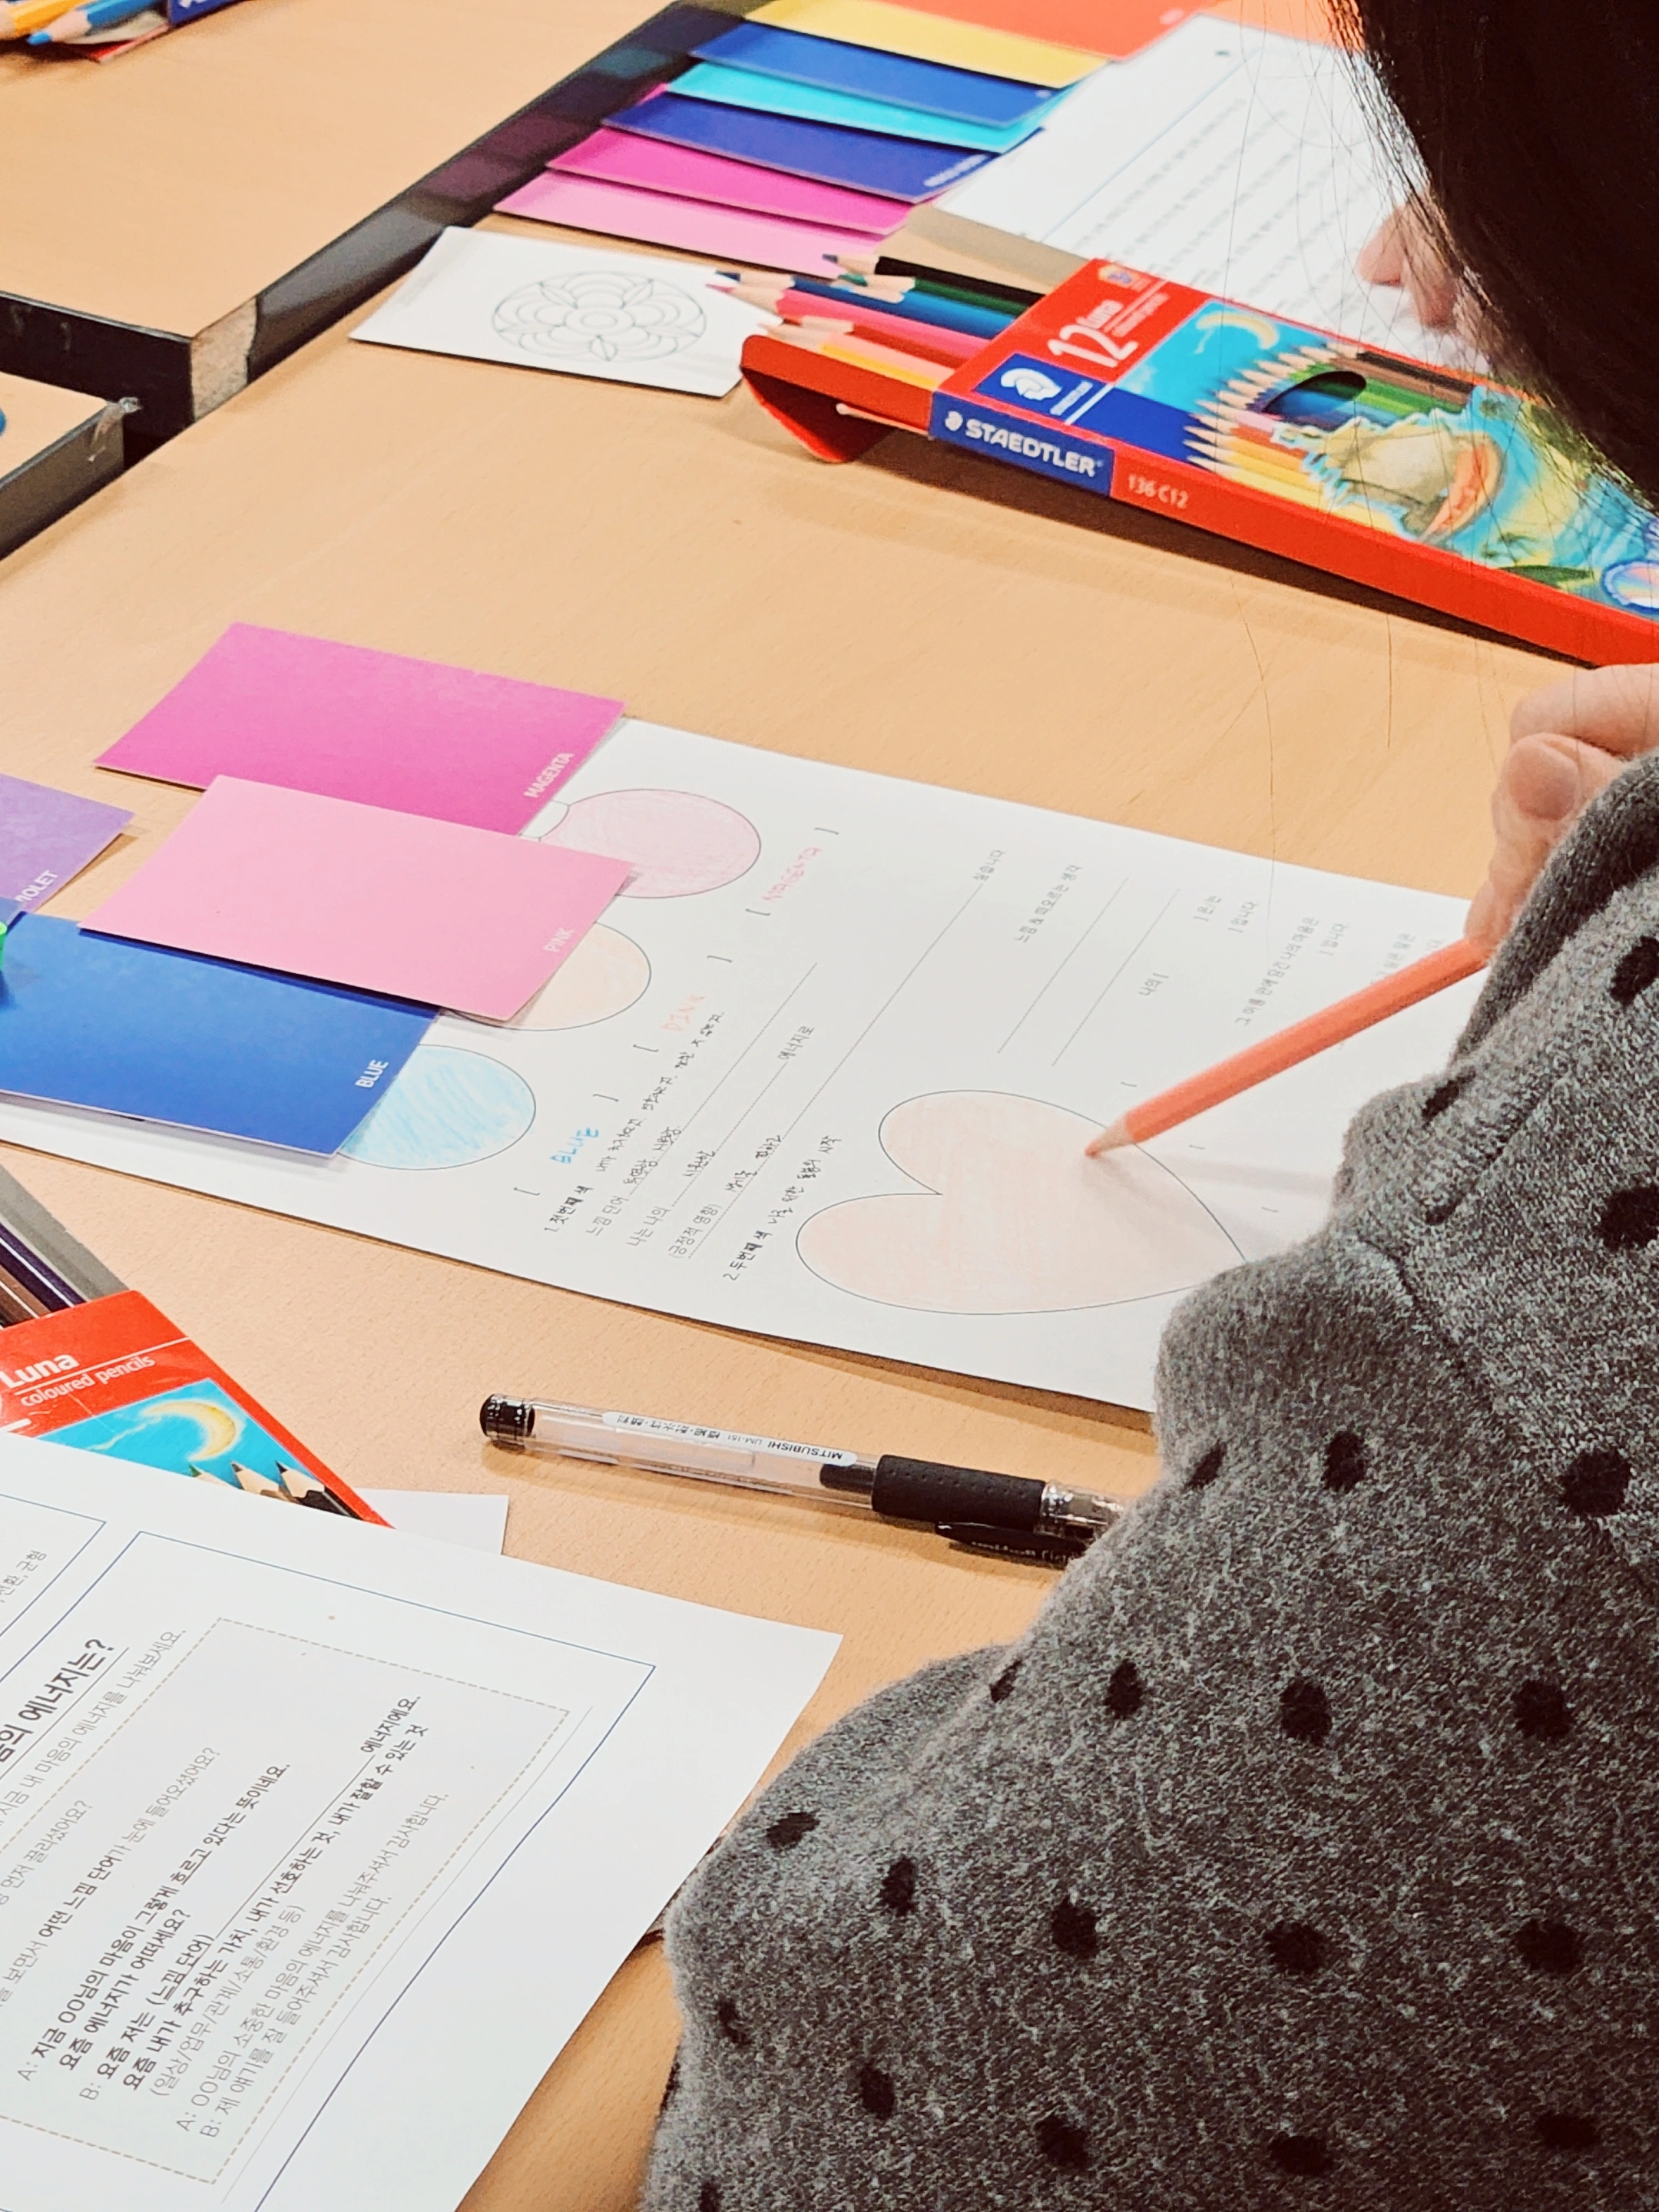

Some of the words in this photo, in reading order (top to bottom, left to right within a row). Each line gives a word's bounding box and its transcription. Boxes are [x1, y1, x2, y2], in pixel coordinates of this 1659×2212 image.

[1047, 323, 1138, 368] 12
[965, 418, 1095, 478] STAEDTLER
[524, 753, 575, 800] MAGENTA
[13, 869, 58, 902] IOLET
[543, 927, 575, 954] PINK
[778, 1026, 814, 1059] 에너지로
[355, 1059, 389, 1089] BLUE
[551, 1128, 598, 1163] BLUE
[586, 1216, 612, 1236] 느낌
[601, 1196, 629, 1214] 단어
[627, 1228, 654, 1246] 나는
[644, 1207, 671, 1225] 나의
[668, 1227, 704, 1258] (긍정적
[693, 1204, 722, 1224] 영향)
[0, 1353, 79, 1387] Luna
[21, 1374, 94, 1407] coloured
[97, 1354, 156, 1385] pencils
[767, 1439, 843, 1461] MITSUBISHI
[16, 1550, 47, 1571] 균형
[18, 1639, 114, 1720] 에너지는?
[19, 1774, 45, 1787] 내
[35, 1737, 81, 1773] 마음의
[72, 1691, 127, 1735] 에너지를
[117, 1631, 186, 1688] 나눠보세요.
[0, 1865, 34, 1888] 먼저
[23, 1800, 91, 1863] 끌리셨어요?
[2, 1941, 48, 1984] 보면서
[38, 1910, 74, 1937] 어떤
[63, 1882, 98, 1909] 느낌
[87, 1845, 131, 1880] 단어가
[121, 1818, 155, 1843] 눈에
[145, 1747, 220, 1817] 들어오셨어요?
[17, 2062, 38, 2081] A:
[31, 2028, 68, 2058] 지금
[98, 1926, 145, 1966] 마음이
[134, 1886, 179, 1925] 그렇게
[170, 1849, 212, 1886] 흐르고
[203, 1812, 247, 1846] 있다는
[235, 1764, 290, 1810] 뜻이네요.
[79, 2083, 101, 2100] B:
[97, 2046, 131, 2080] 요즘
[120, 2012, 156, 2043] 저는
[145, 1969, 189, 2005] (느낌
[175, 1935, 217, 1970] 단어)
[360, 1697, 421, 1756] 에너지에요.
[123, 2057, 157, 2091] 요즘
[146, 2020, 182, 2052] 내가
[173, 1959, 229, 2016] 추구하는
[217, 1929, 258, 1953] 가치,
[245, 1897, 280, 1922] 내가
[270, 1847, 323, 1894] 선호하는
[310, 1831, 341, 1844] 것,
[327, 1803, 361, 1825] 내가
[349, 1778, 384, 1800] 잘할
[375, 1764, 393, 1776] 수
[385, 1740, 417, 1761] 있는
[405, 1724, 429, 1737] 것
[278, 1906, 306, 1923] 등)
[176, 2112, 197, 2131] A:
[233, 2003, 275, 2048] 소중한
[264, 1959, 309, 1999] 마음의
[298, 1909, 349, 1956] 에너지를
[338, 1849, 399, 1906] 나눠주셔서
[386, 1795, 449, 1848] 감사합니다.
[59, 2038, 94, 2071] 요즘
[84, 1974, 139, 2033] 에너지가
[130, 1909, 190, 1969] 어떠세요?
[200, 2120, 221, 2137] B:
[214, 2097, 240, 2115] 제
[261, 2028, 287, 2044] 잘
[276, 1960, 339, 2025] 들어주셔서
[326, 1897, 391, 1958] 감사합니다.
